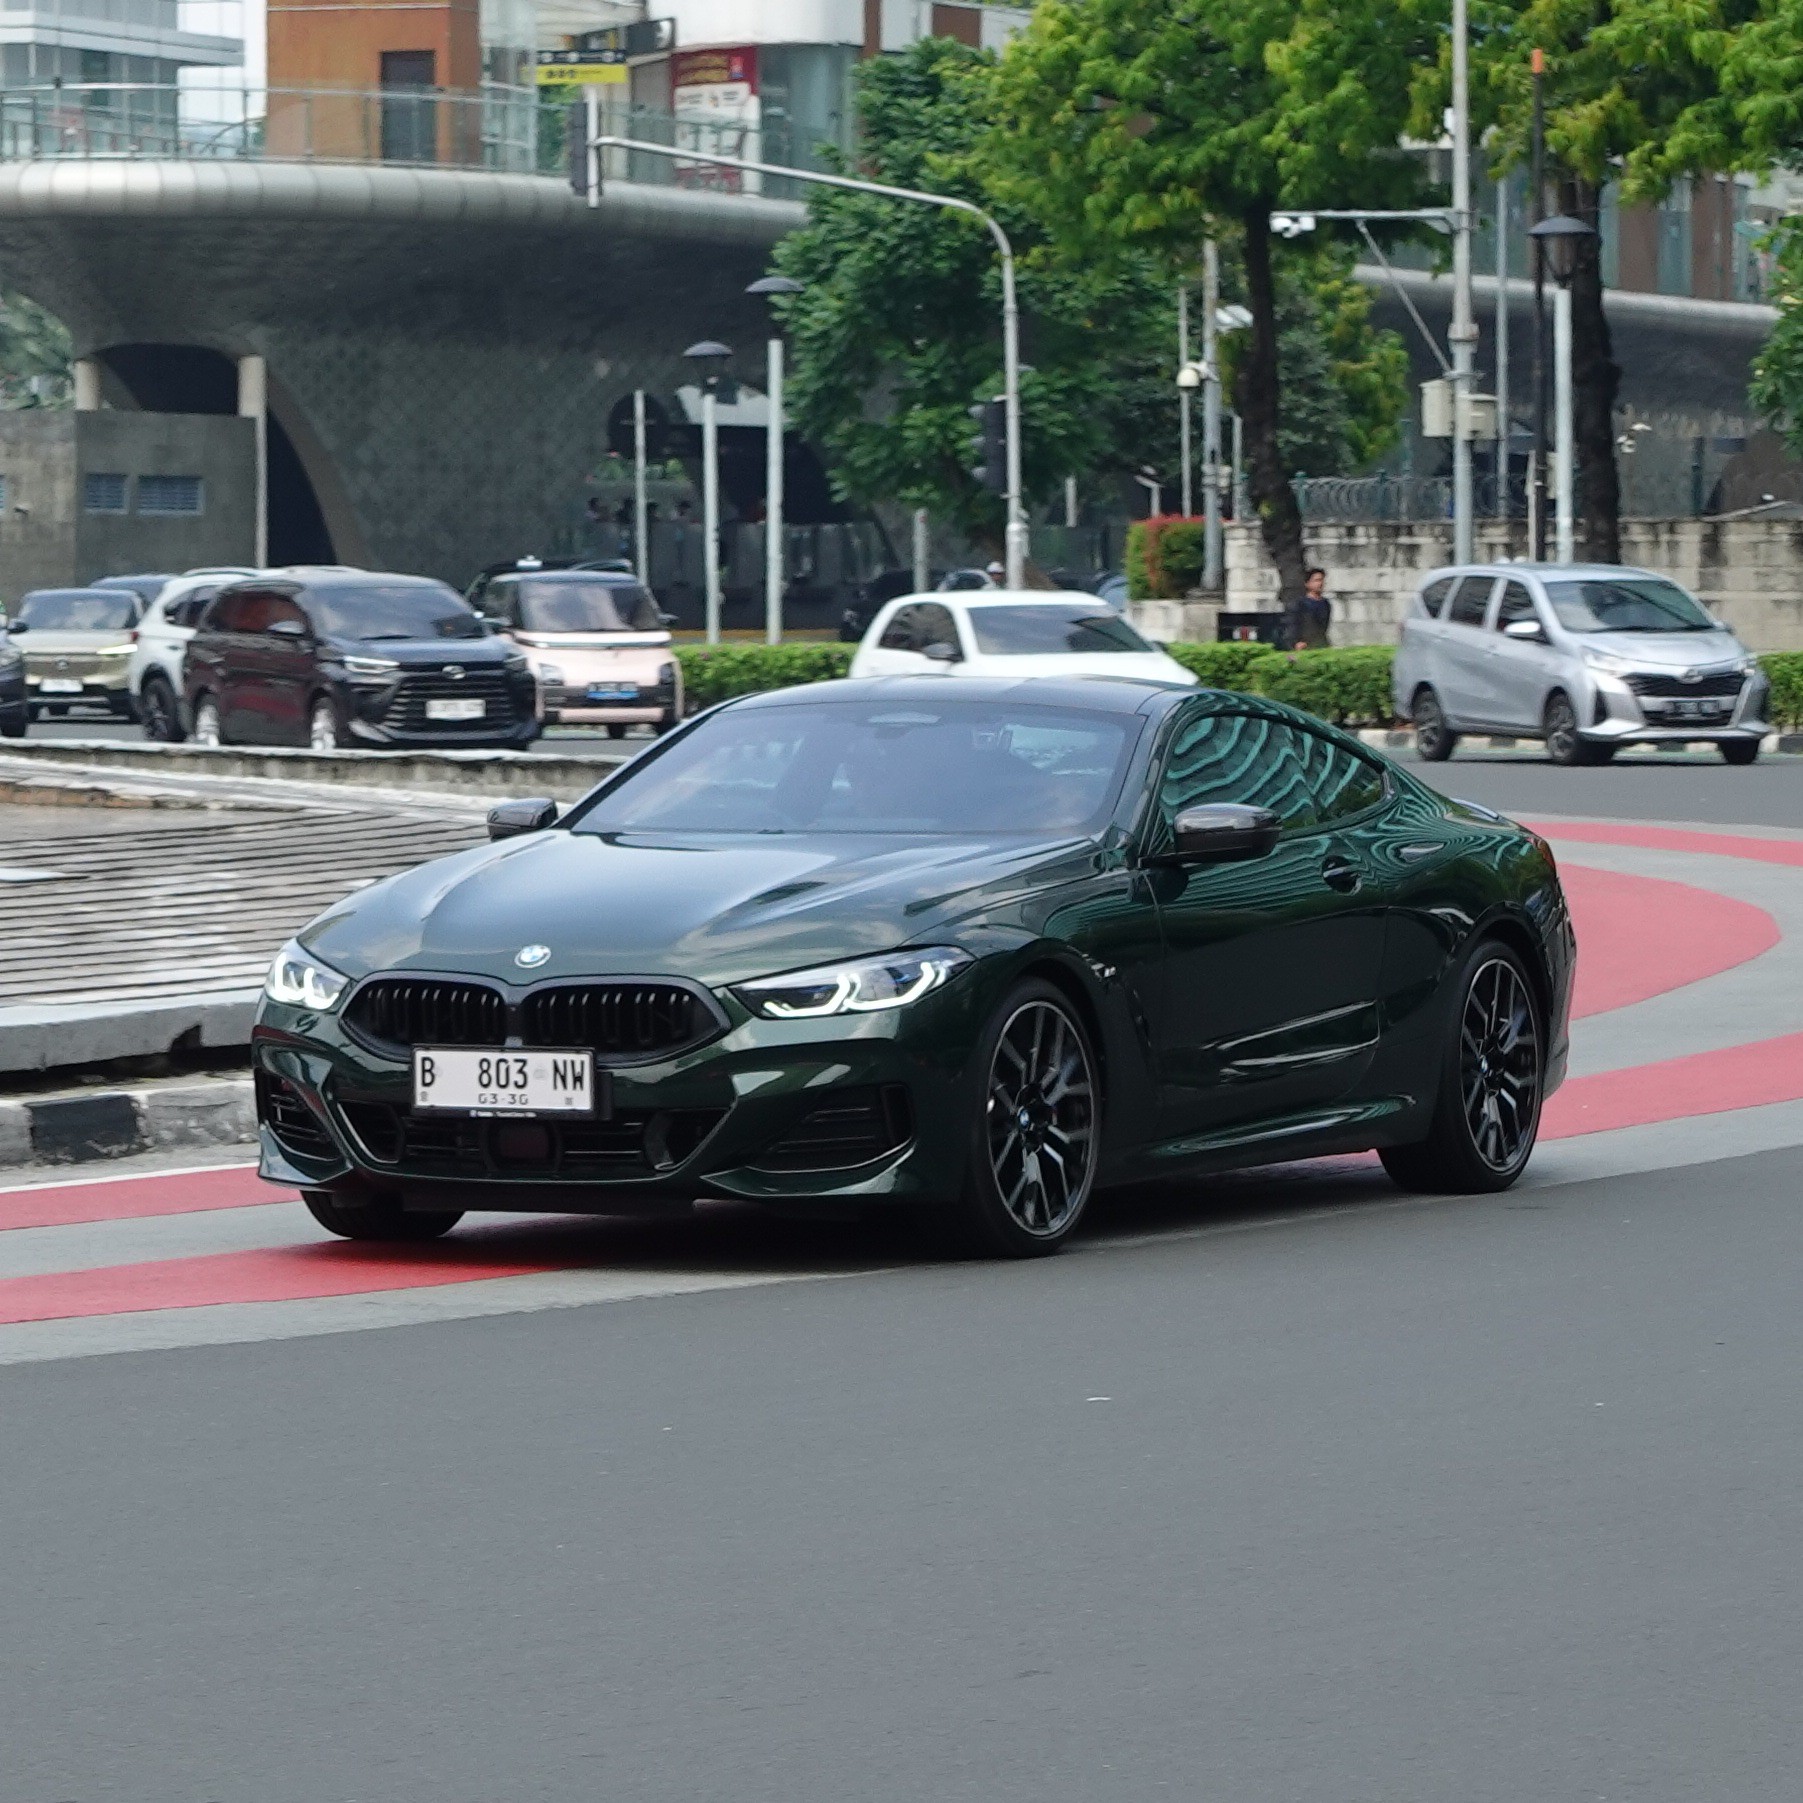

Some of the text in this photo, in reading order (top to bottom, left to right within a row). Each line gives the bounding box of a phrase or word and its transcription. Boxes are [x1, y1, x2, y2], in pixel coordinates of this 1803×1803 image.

[420, 1056, 586, 1091] B 803 NW
